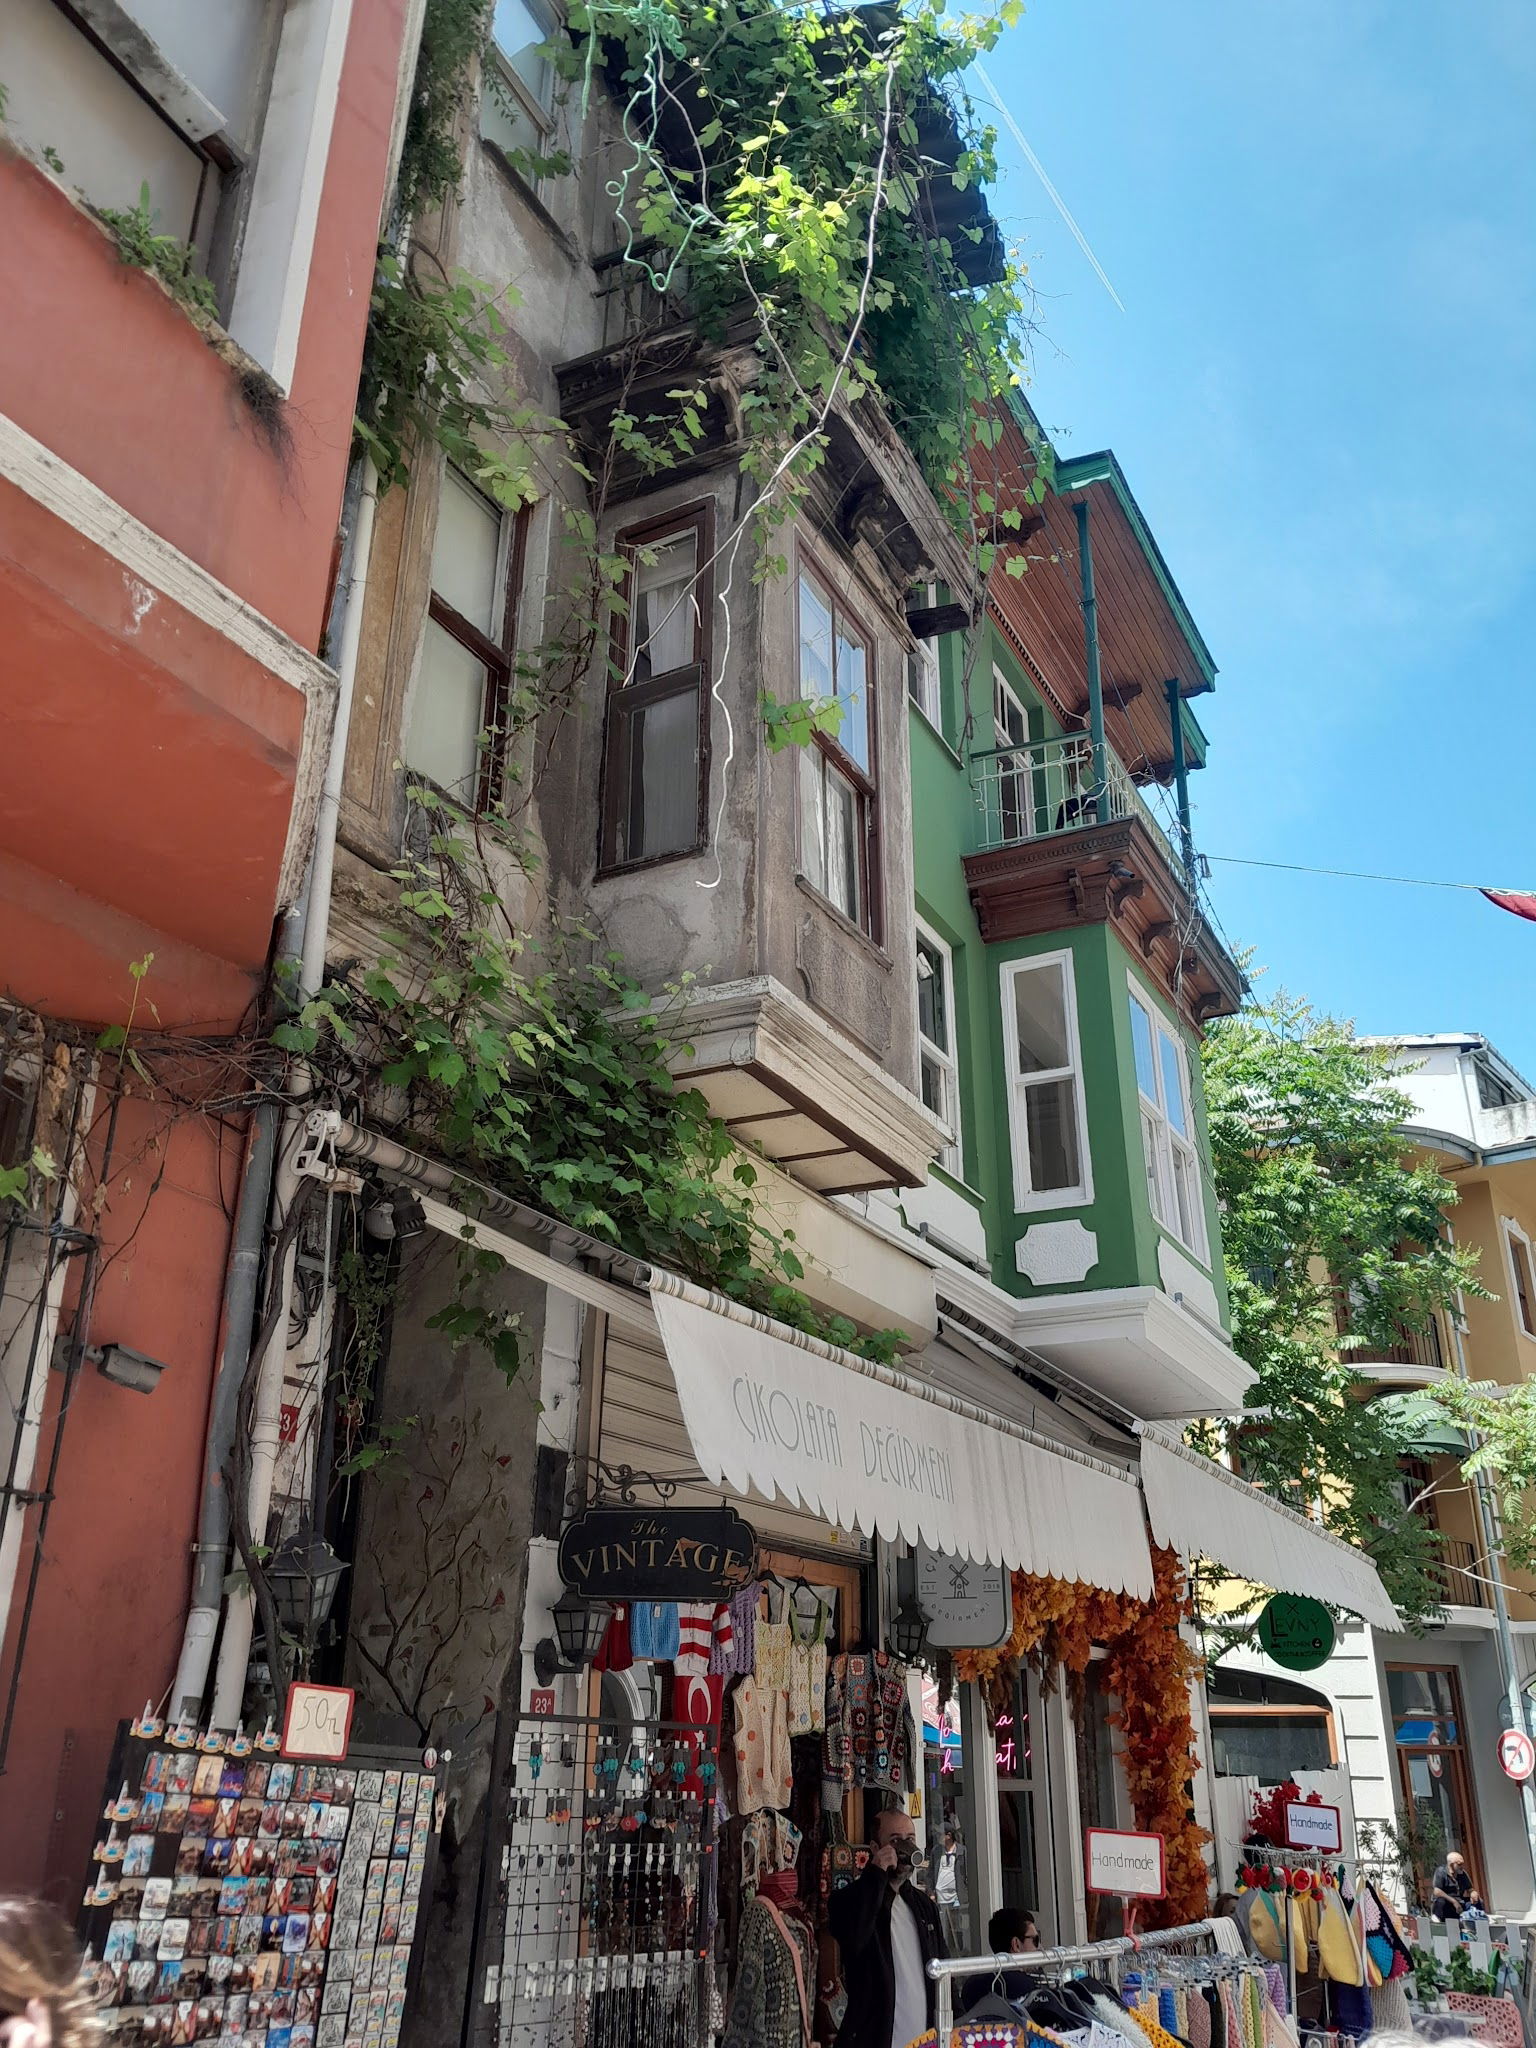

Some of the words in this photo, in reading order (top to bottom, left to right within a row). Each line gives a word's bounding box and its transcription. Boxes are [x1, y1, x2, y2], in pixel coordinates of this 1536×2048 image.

[733, 1372, 843, 1468] ÇİKOLATA
[630, 1518, 669, 1536] The
[570, 1538, 747, 1580] VINTAGE
[1290, 1813, 1333, 1831] Handmade
[1092, 1851, 1154, 1871] Handmade
